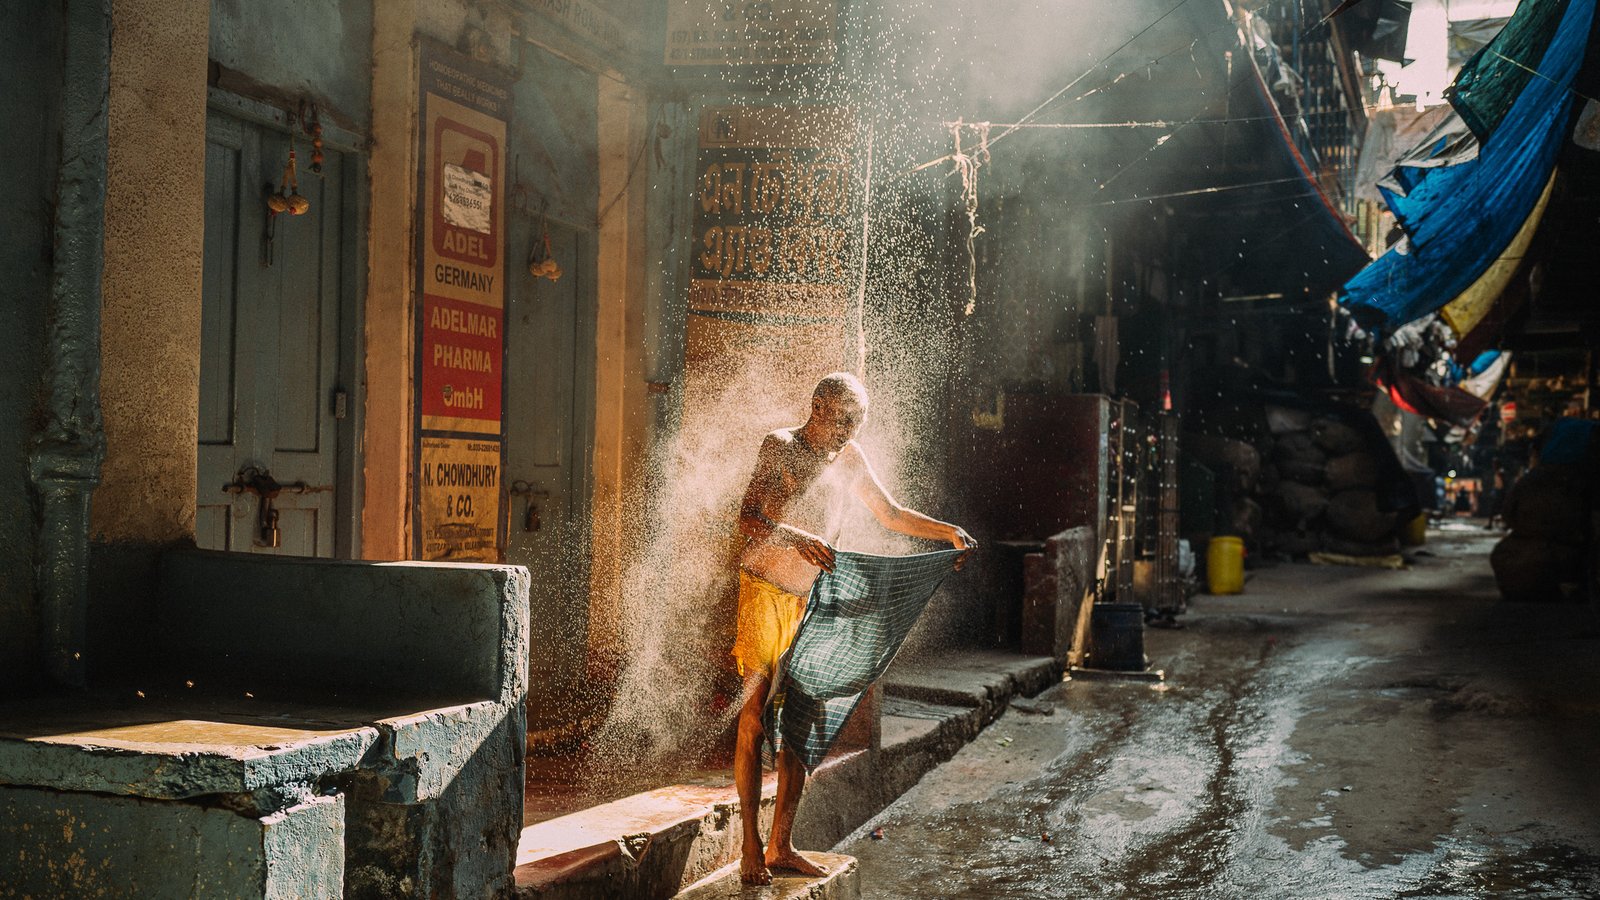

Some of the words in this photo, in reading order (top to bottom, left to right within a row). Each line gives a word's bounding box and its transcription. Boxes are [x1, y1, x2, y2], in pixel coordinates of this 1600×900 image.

[722, 2, 737, 21] &
[442, 230, 488, 259] ADEL
[435, 263, 494, 293] GERMANY
[431, 306, 497, 338] ADELMAR
[433, 344, 492, 373] PHARMA
[424, 463, 434, 487] N.
[437, 463, 497, 487] CHOWDHURY
[447, 495, 453, 517] &
[456, 495, 474, 517] CO.
